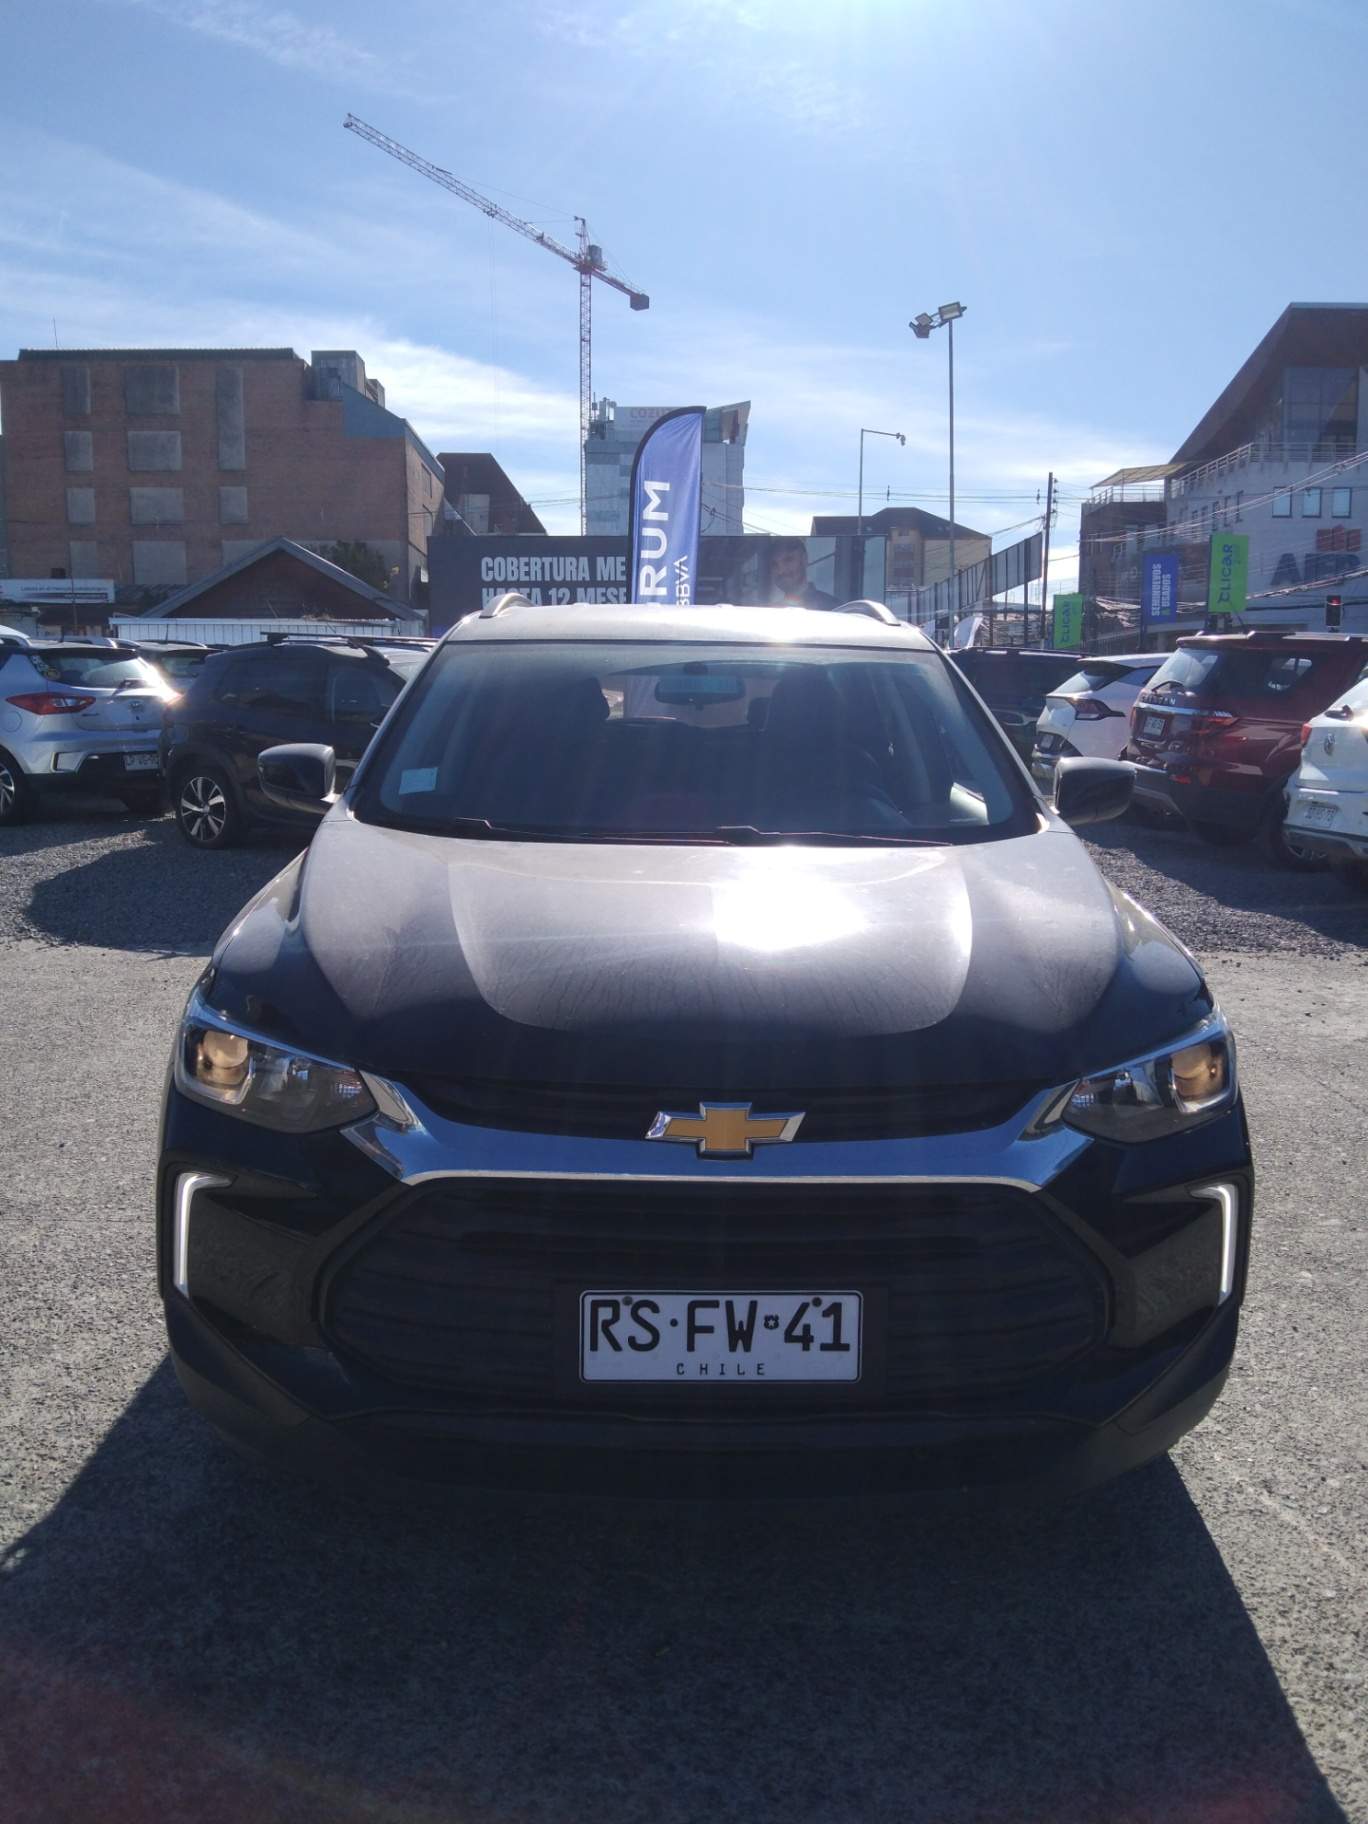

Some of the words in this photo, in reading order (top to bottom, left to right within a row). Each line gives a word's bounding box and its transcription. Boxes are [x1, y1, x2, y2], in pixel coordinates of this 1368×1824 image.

[639, 480, 671, 606] RUM
[481, 556, 590, 582] COBERTURA
[597, 556, 627, 581] ME
[482, 587, 542, 607] HTA
[548, 587, 571, 605] 12
[1161, 574, 1171, 607] USADOS
[676, 1363, 766, 1376] CHILE
